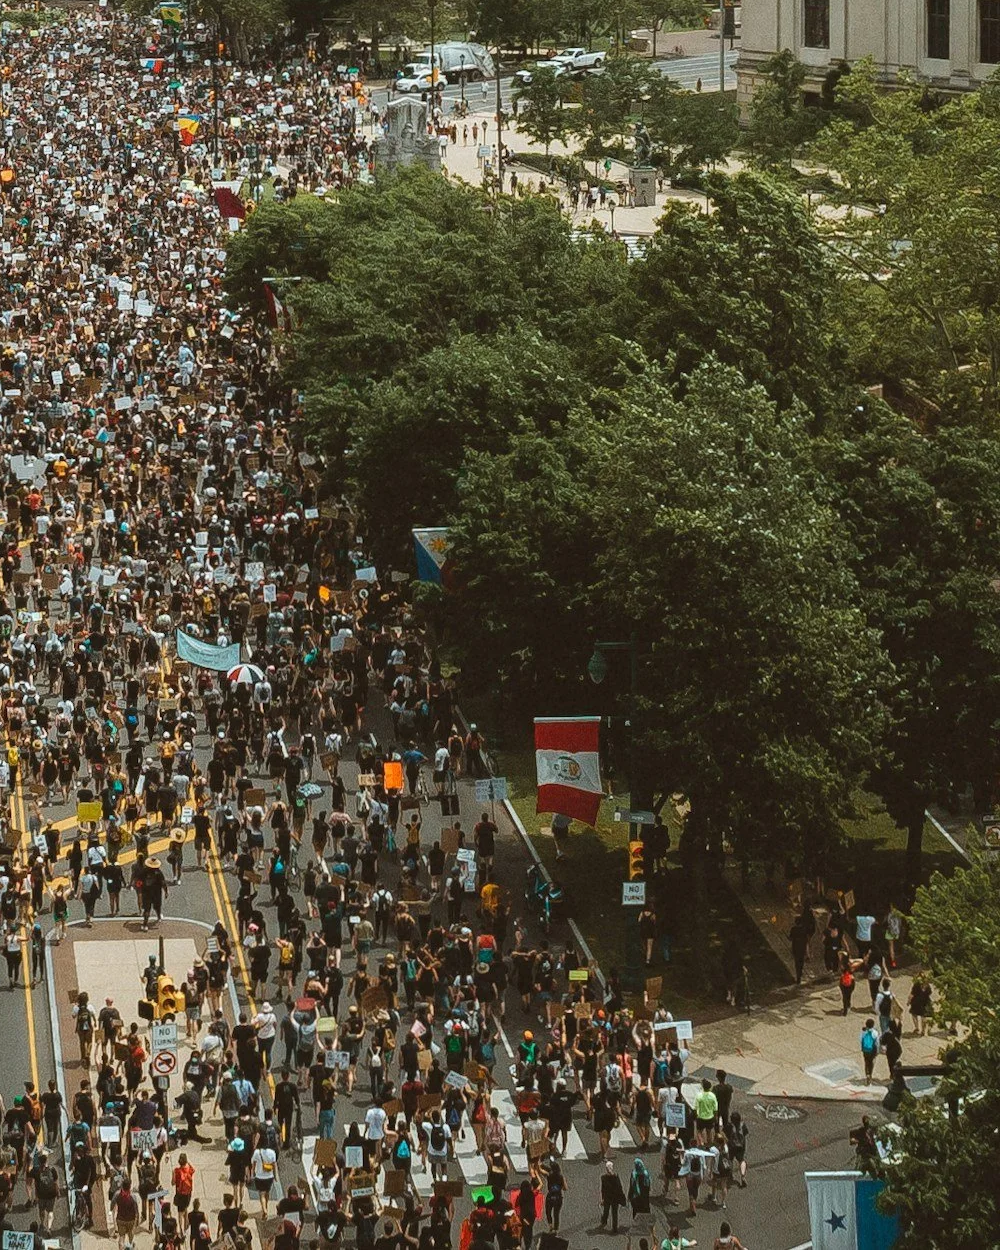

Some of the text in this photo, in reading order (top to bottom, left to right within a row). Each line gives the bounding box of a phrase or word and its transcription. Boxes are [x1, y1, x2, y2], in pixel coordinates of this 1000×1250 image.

[628, 885, 640, 893] NO
[158, 1028, 171, 1036] NO
[154, 1038, 177, 1046] TURNS
